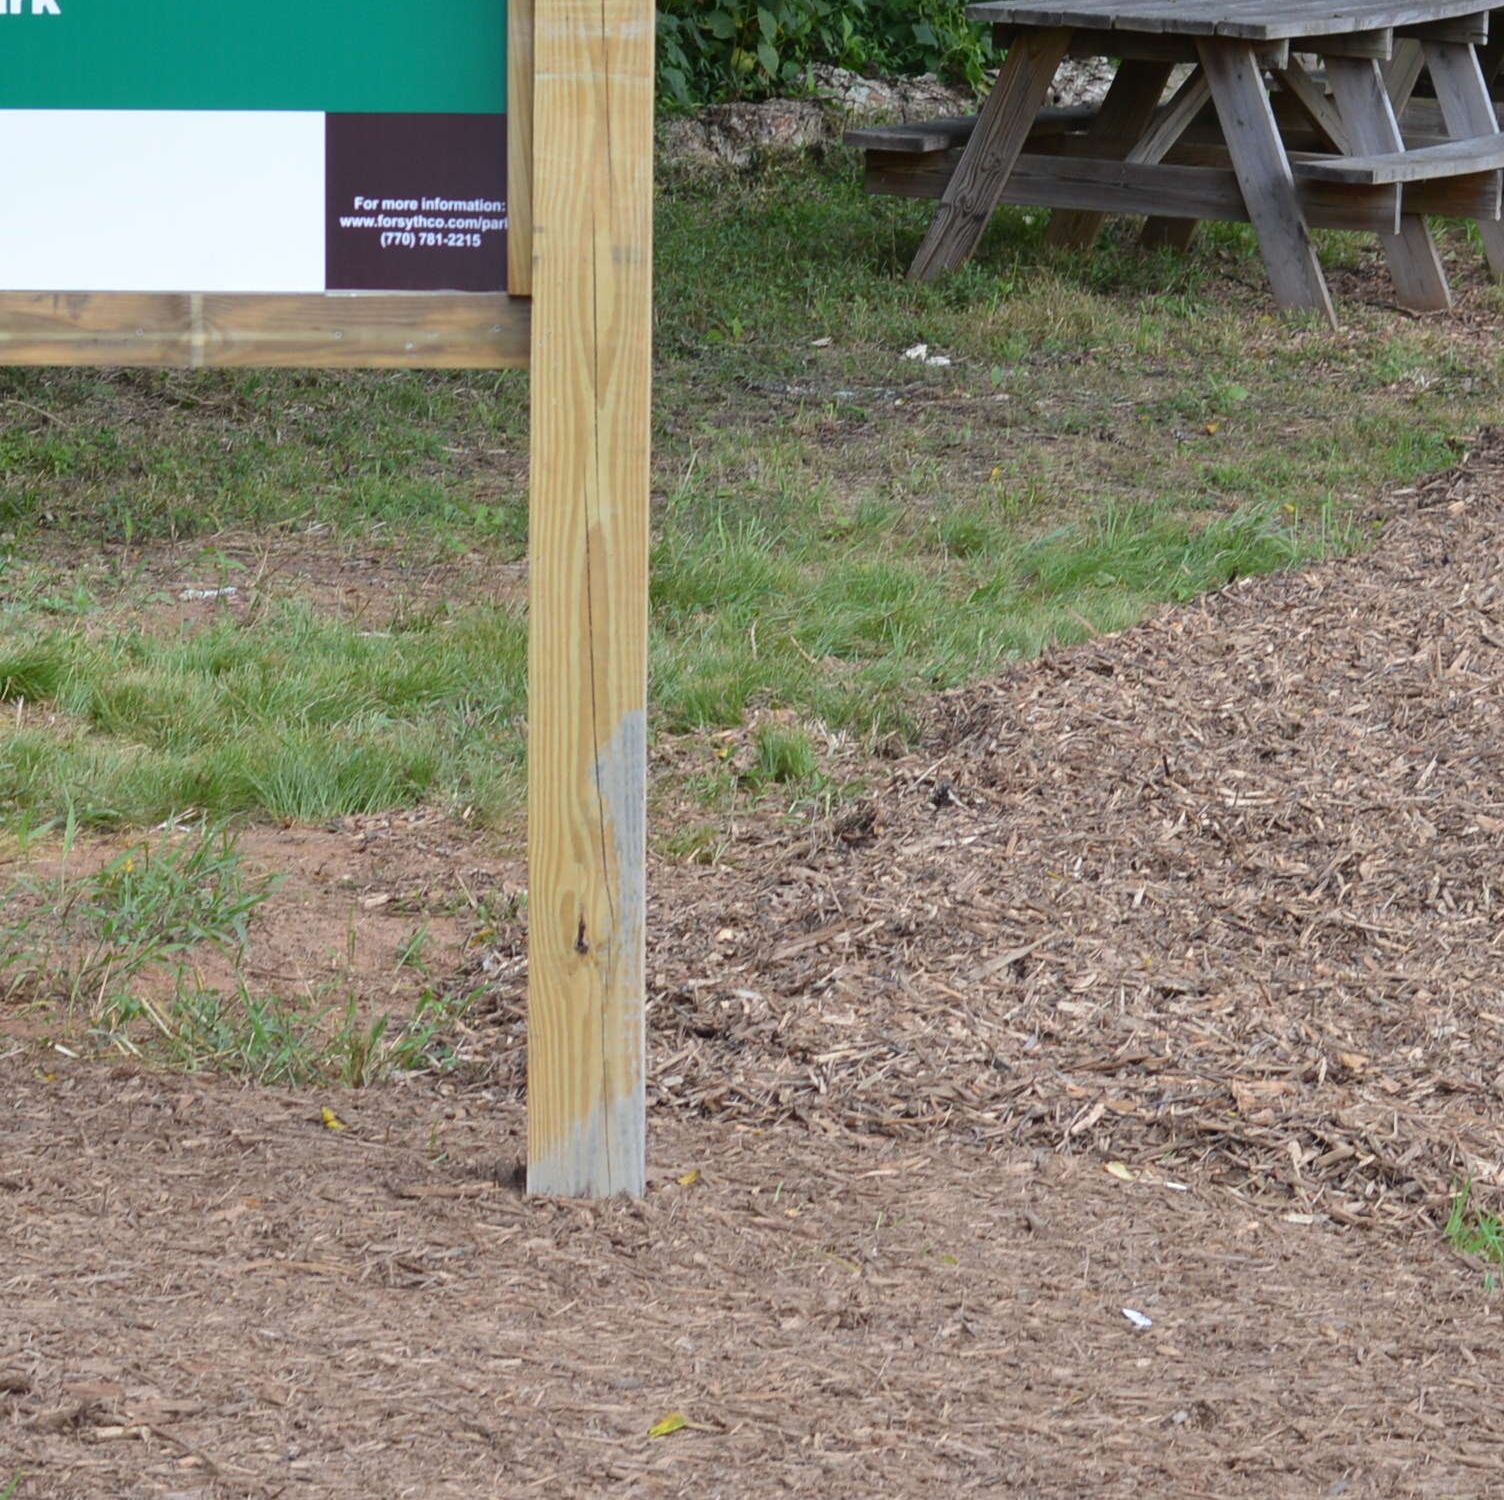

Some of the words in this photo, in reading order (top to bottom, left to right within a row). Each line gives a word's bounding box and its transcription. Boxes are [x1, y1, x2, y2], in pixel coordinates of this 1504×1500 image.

[353, 196, 379, 210] For
[381, 198, 418, 211] more
[421, 197, 507, 213] information:
[380, 231, 416, 249] (770)
[418, 231, 482, 248] 781-2215
